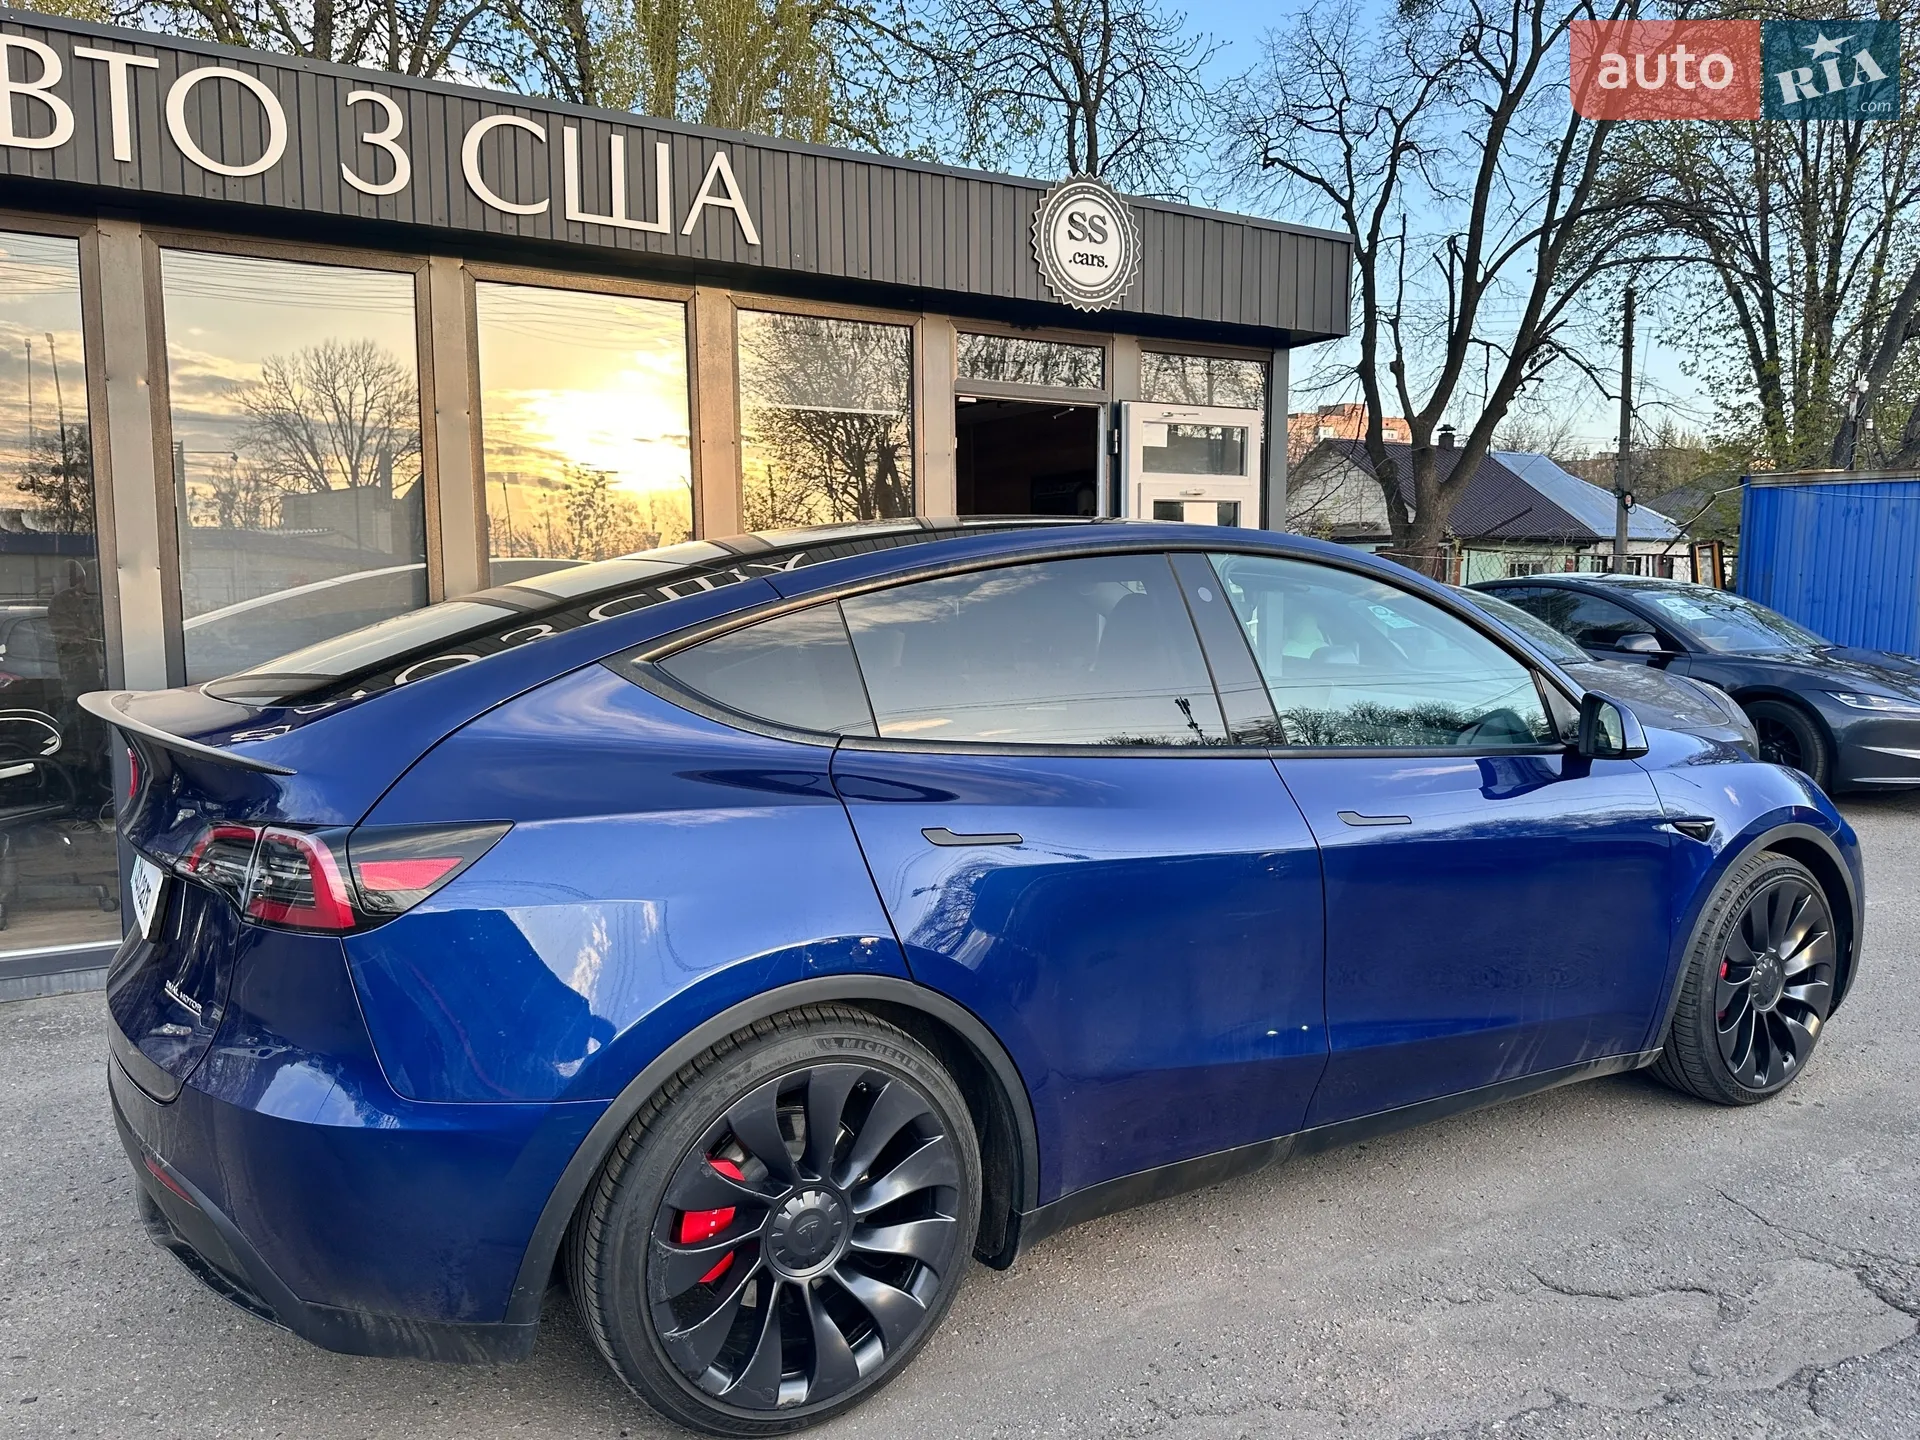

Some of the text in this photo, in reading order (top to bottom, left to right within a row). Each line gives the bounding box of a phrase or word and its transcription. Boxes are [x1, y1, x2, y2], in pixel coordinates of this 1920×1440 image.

[0, 34, 288, 177] ВТО
[461, 114, 761, 245] США
[1067, 211, 1108, 244] SS
[843, 1039, 919, 1071] MICHELIN
